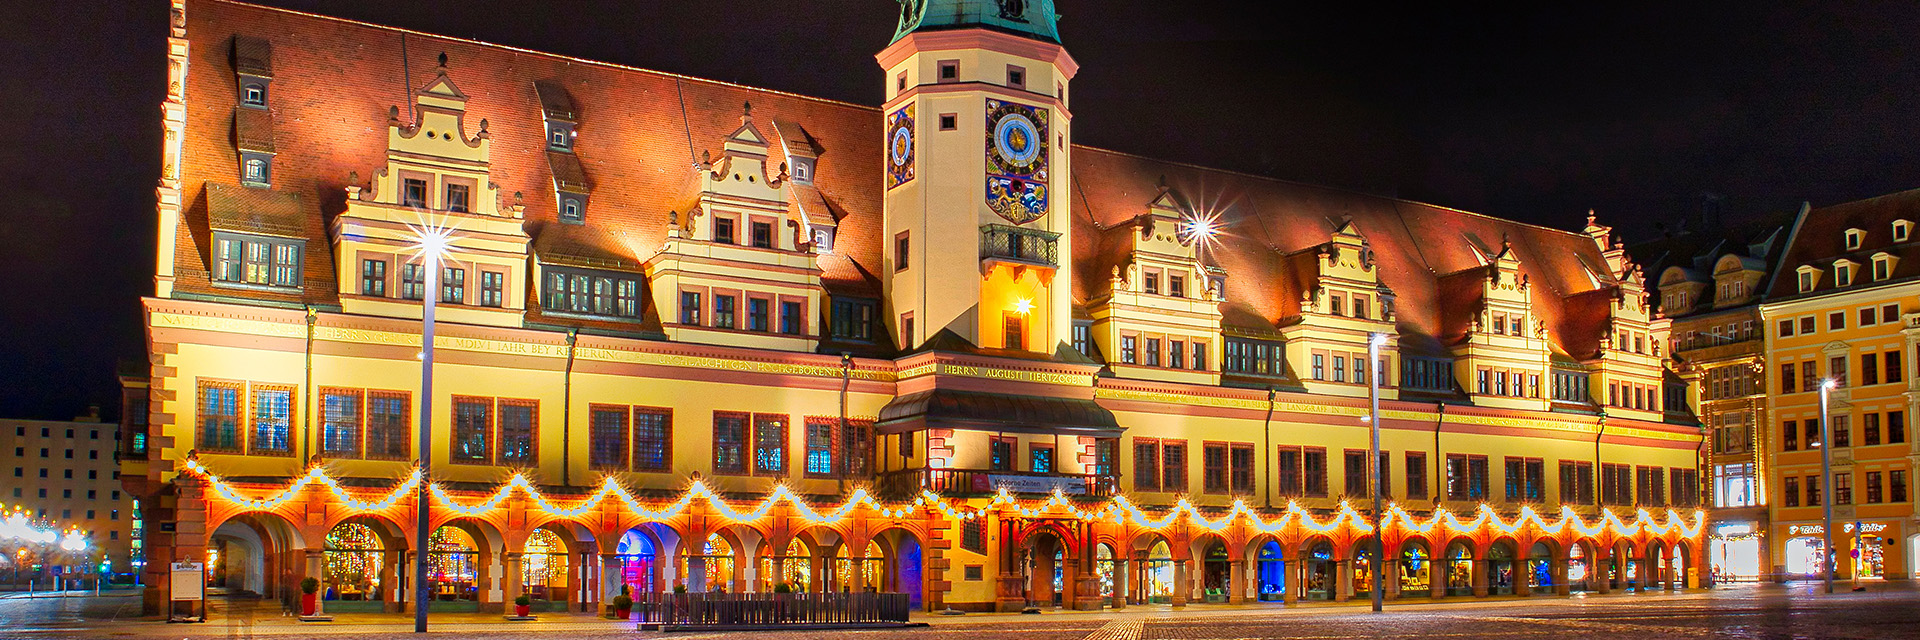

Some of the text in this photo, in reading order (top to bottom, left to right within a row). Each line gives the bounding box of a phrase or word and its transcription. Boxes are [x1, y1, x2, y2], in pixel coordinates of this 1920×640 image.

[531, 344, 551, 355] BEY
[944, 364, 979, 376] HERRN
[1029, 371, 1084, 385] HERTZOGEN
